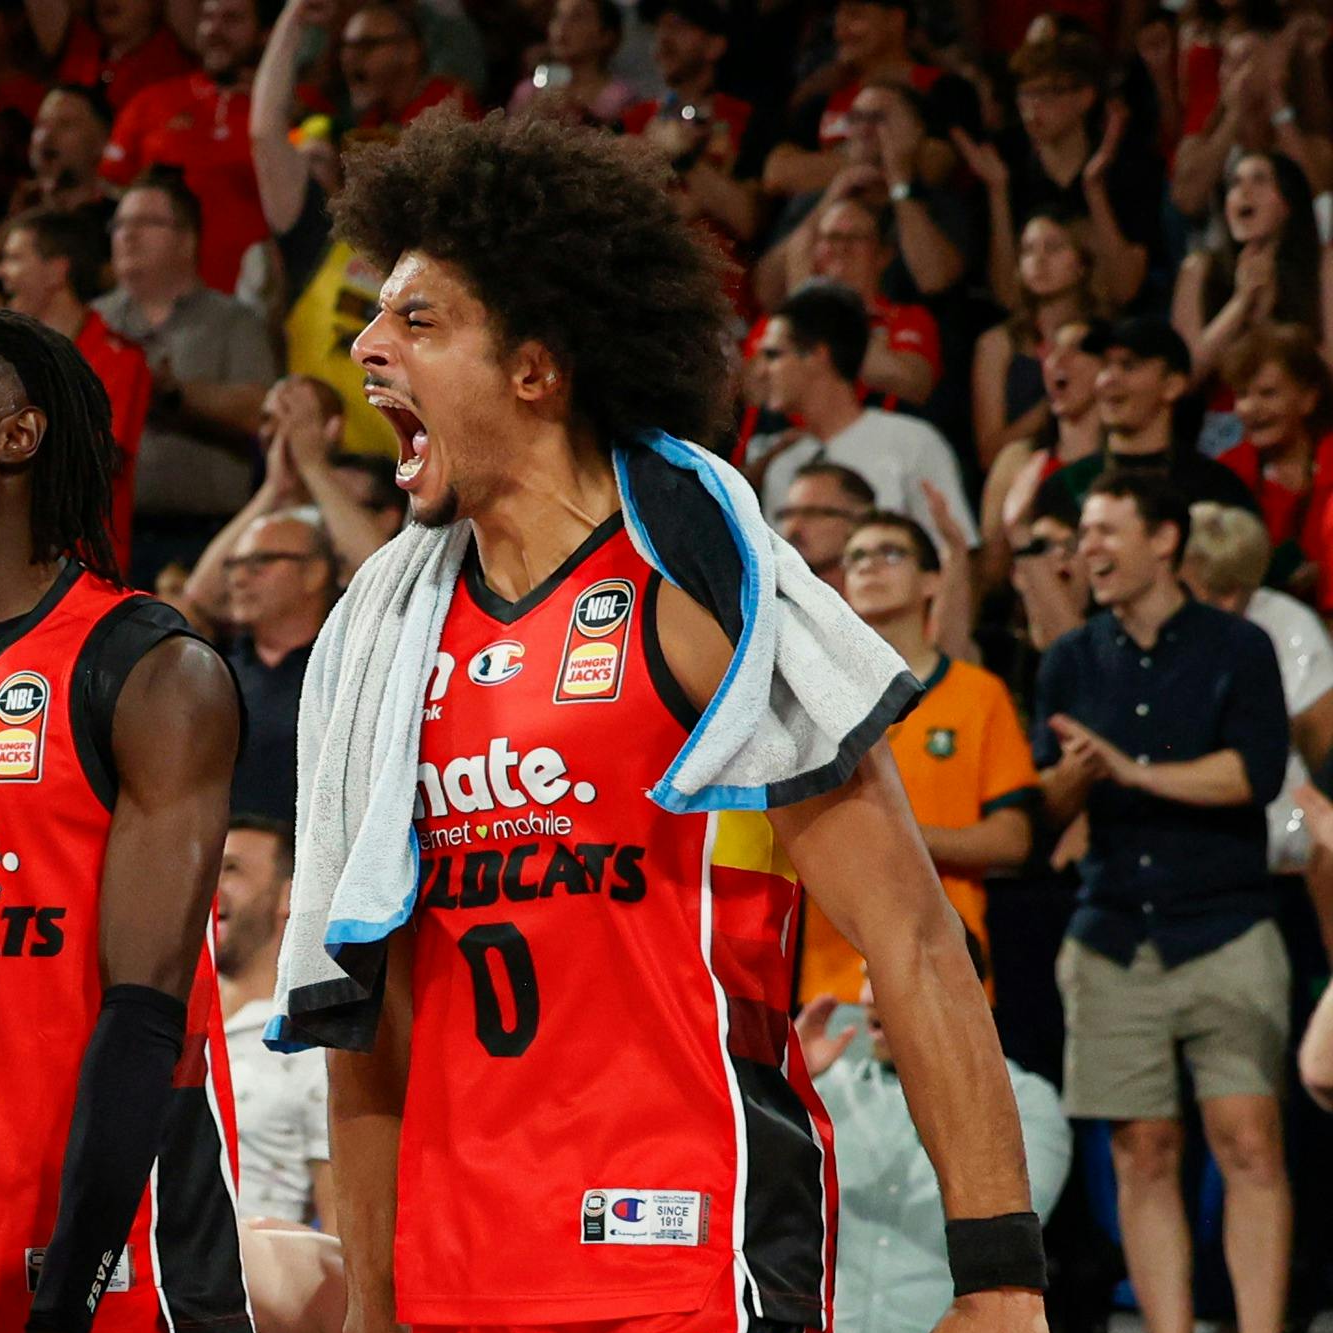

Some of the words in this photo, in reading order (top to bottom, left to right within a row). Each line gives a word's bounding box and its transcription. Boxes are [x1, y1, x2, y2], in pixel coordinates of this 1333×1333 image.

[585, 595, 618, 621] NBL
[570, 657, 613, 670] HUNGRY
[567, 669, 612, 683] JACK'S
[6, 688, 34, 711] NBL
[493, 811, 572, 840] mobile
[420, 841, 647, 910] LDCATS
[458, 922, 540, 1057] 0
[657, 1205, 689, 1217] SINCE
[660, 1217, 684, 1227] 1919
